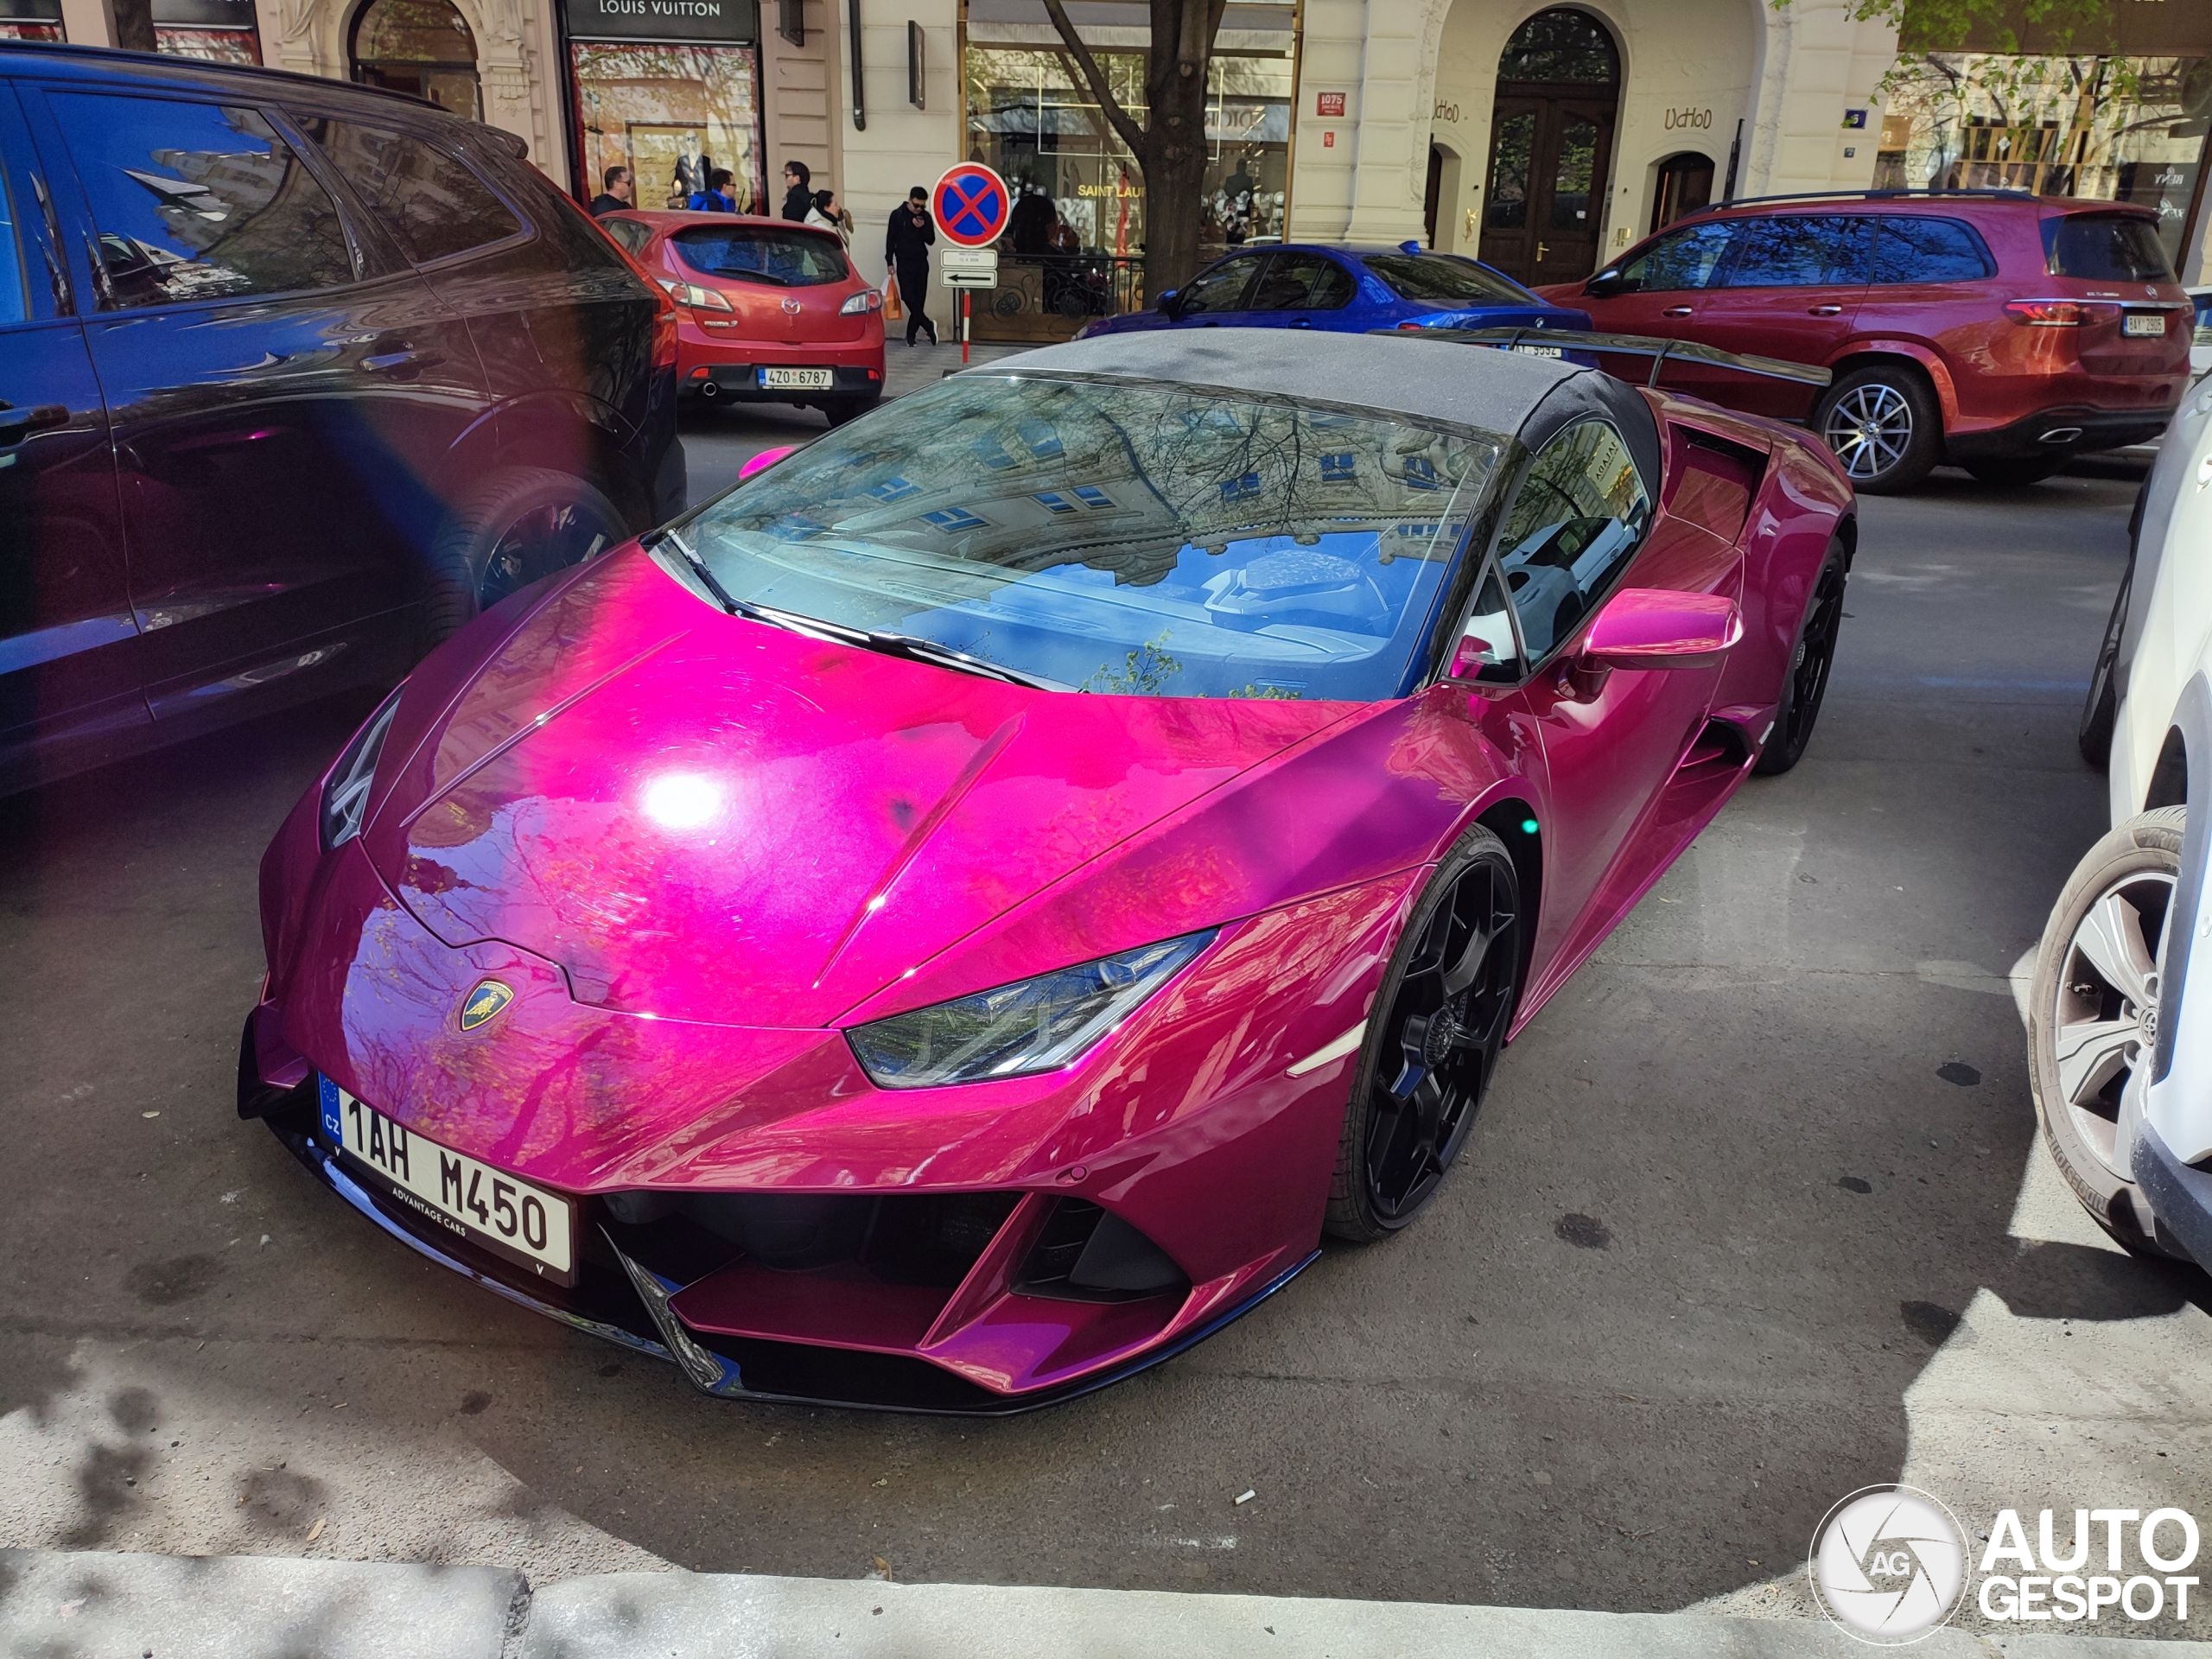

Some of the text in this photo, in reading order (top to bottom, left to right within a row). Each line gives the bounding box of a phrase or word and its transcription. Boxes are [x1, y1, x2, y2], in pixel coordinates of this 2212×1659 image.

[600, 0, 721, 16] LOUIS VUITTON
[1321, 94, 1343, 105] 1075
[1077, 184, 1114, 197] SAINT
[798, 371, 827, 385] 6787
[325, 1114, 340, 1136] CZ
[349, 1099, 547, 1251] 1AH M450
[391, 1186, 467, 1238] ADVANTAGE CARS
